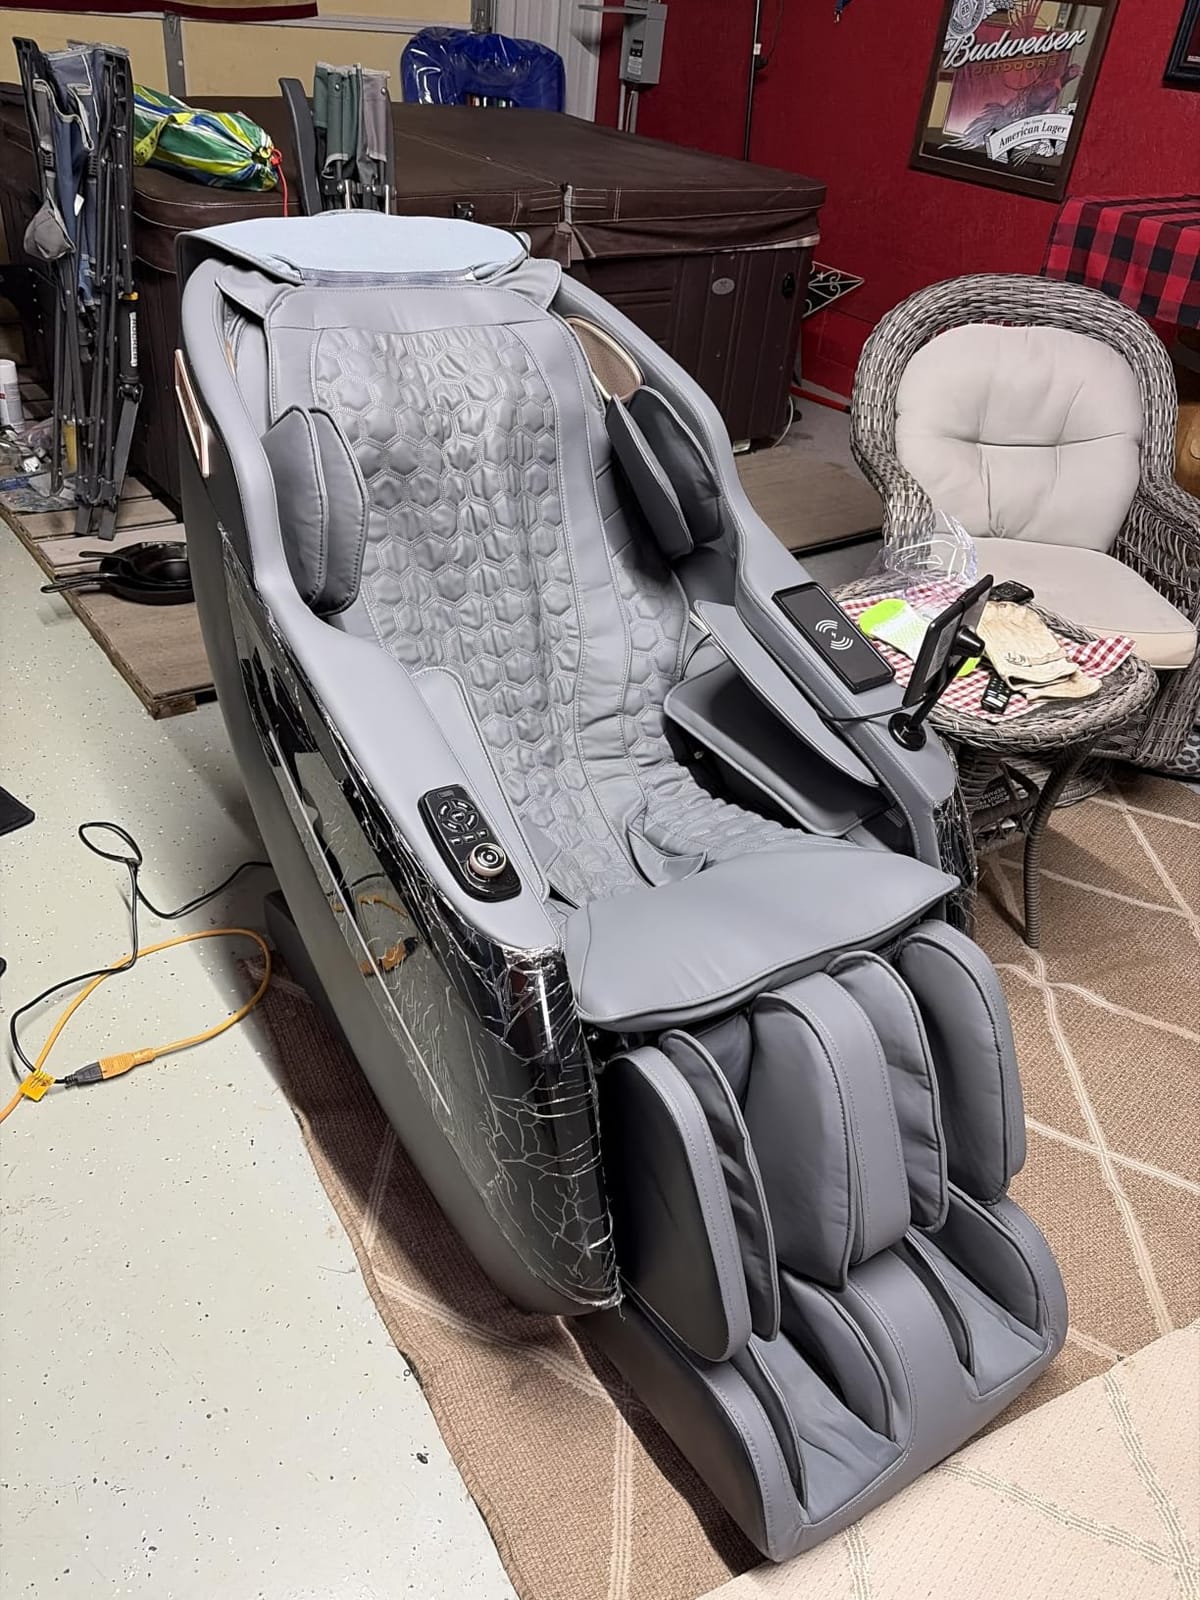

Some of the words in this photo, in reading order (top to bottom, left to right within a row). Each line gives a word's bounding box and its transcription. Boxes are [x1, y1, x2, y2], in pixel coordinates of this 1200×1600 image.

[943, 26, 1087, 69] Budweiser
[999, 125, 1039, 147] American
[1041, 122, 1067, 134] Lager
